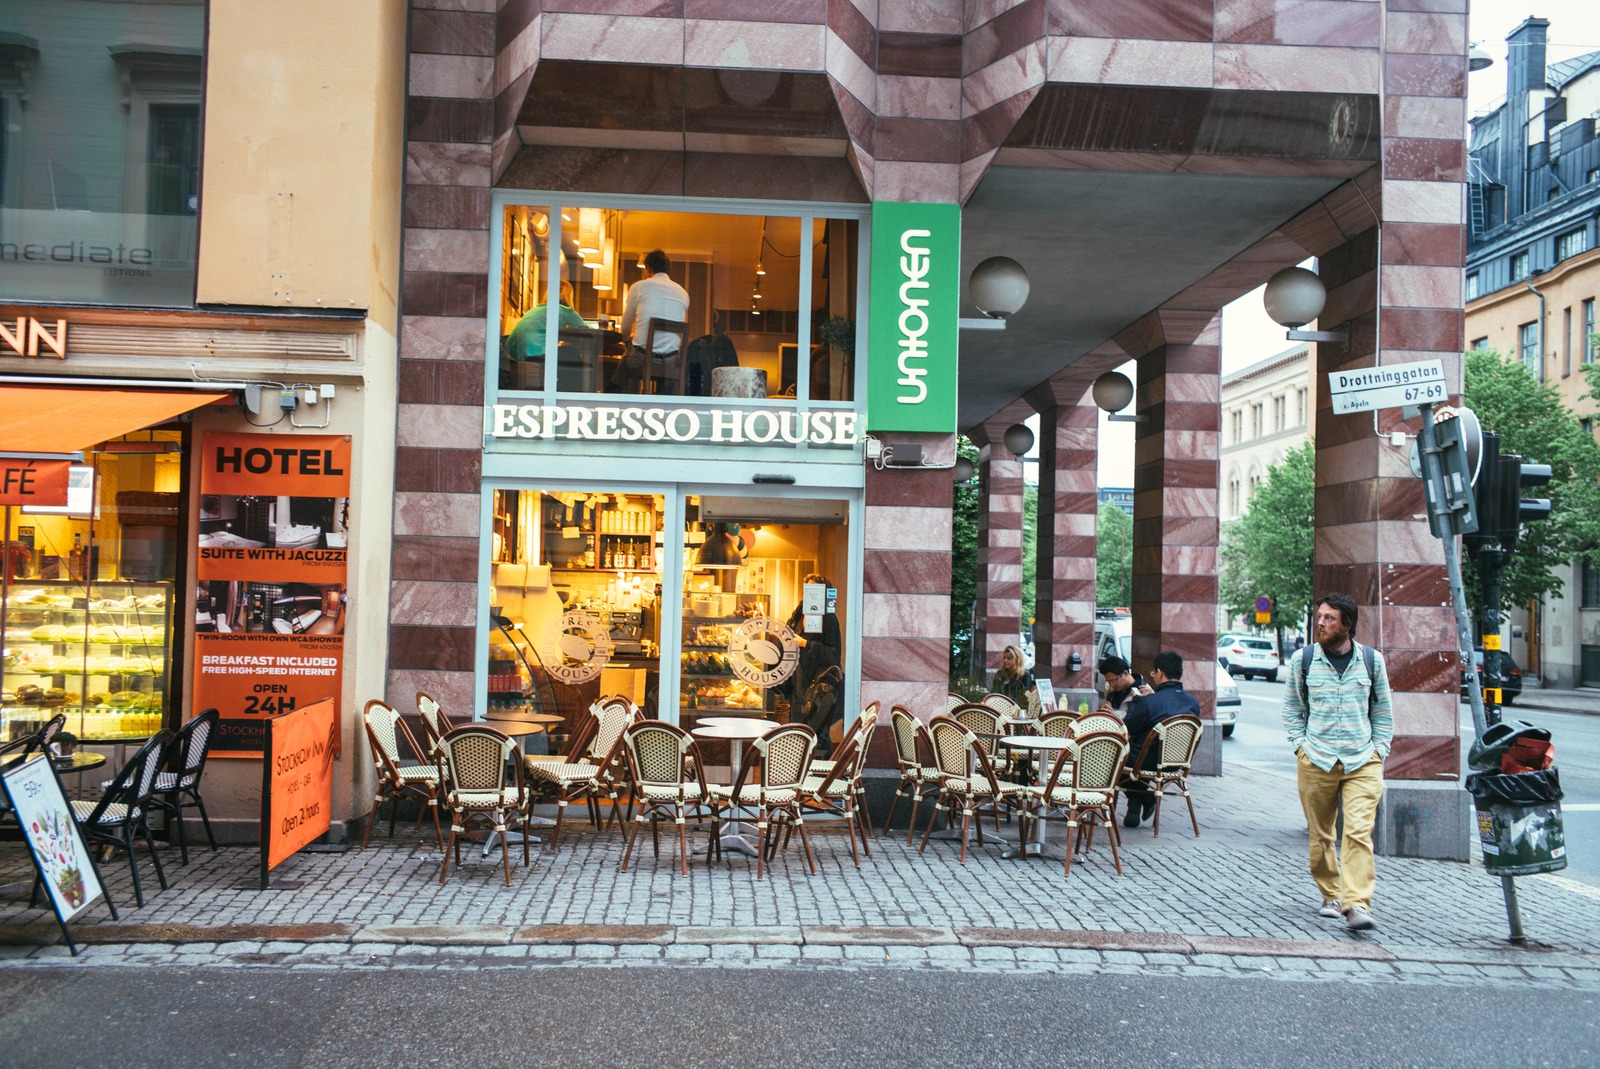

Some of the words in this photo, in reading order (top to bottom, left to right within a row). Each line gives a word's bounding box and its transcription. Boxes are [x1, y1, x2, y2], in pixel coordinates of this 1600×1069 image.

[896, 229, 931, 404] unionen
[1340, 367, 1438, 388] Drottninggatan
[1404, 385, 1442, 401] 67-69
[491, 404, 700, 442] ESPRESSO
[709, 409, 860, 445] HOUSE
[216, 447, 344, 476] HOTEL
[0, 460, 37, 495] FÉ
[201, 548, 245, 559] SUITE
[247, 549, 285, 560] WITH
[288, 550, 346, 562] JACUZZI
[202, 655, 274, 665] BREAKFAST
[276, 656, 337, 667] INCLUDED
[202, 666, 227, 674] FREE
[228, 667, 287, 675] HIGH-SPEED
[289, 667, 337, 676] INTERNET
[740, 666, 787, 683] HOUSE
[253, 684, 288, 693] OPEN
[244, 696, 296, 715] 24H
[281, 815, 299, 838] Open
[305, 802, 320, 821] hours
